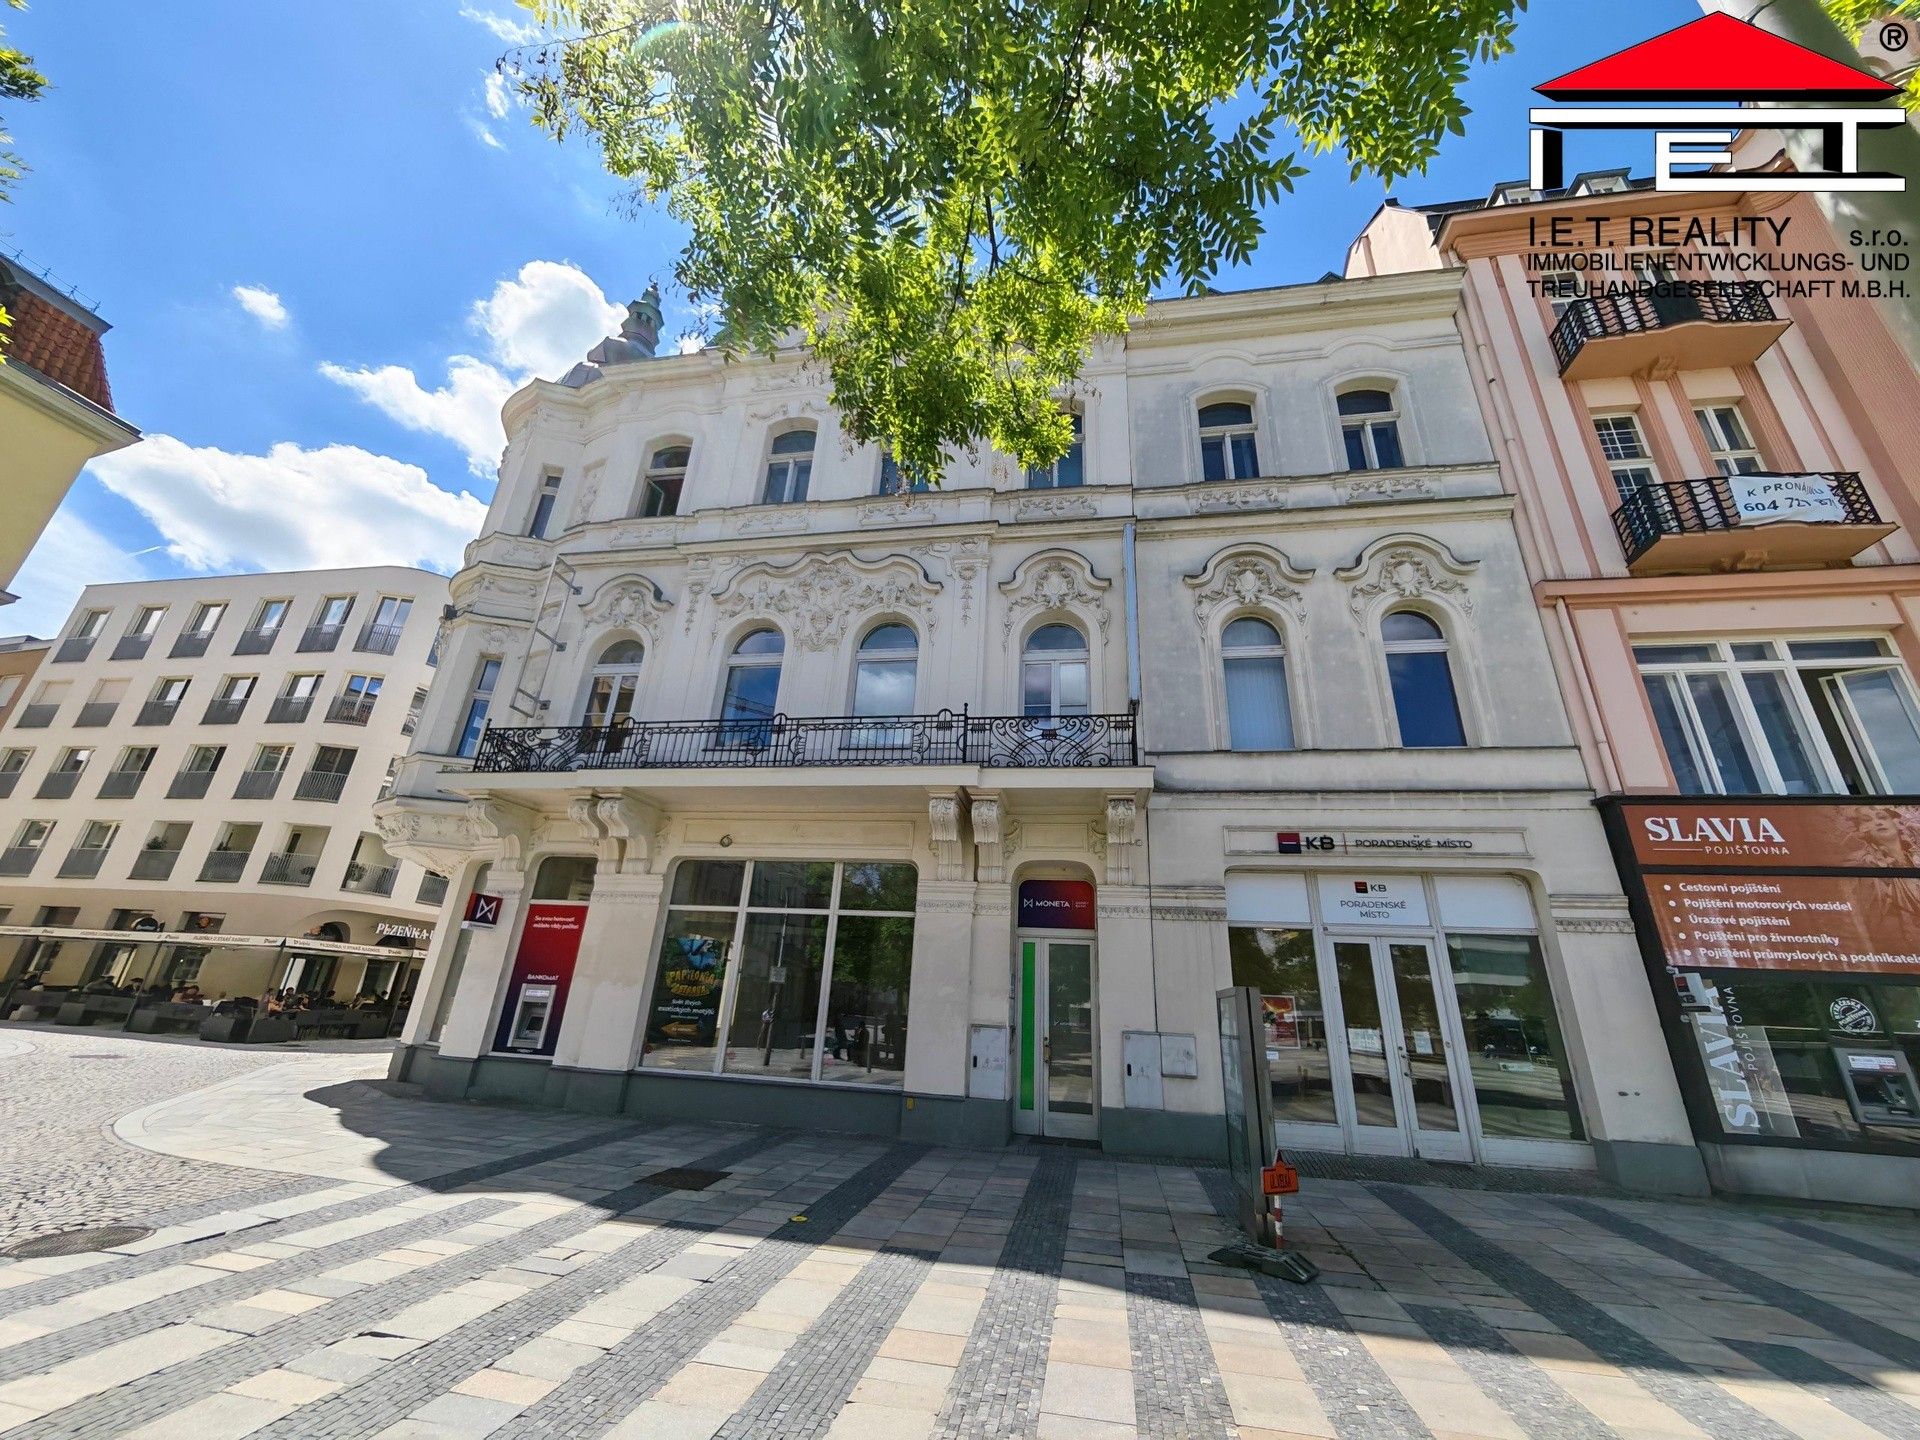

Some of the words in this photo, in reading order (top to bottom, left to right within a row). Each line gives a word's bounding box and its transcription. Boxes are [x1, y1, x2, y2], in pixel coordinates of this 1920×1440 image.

[1747, 489, 1757, 497] K
[1743, 499, 1780, 512] 604
[1644, 817, 1786, 842] SLAVIA
[1305, 835, 1336, 850] KB
[1355, 838, 1432, 849] PORADENSKÉ
[1437, 838, 1474, 849] MÍSTO
[1370, 884, 1387, 893] KB
[1679, 882, 1728, 893] Cestovní
[1730, 883, 1781, 894] pojištění
[1035, 900, 1071, 908] MONETA
[1340, 899, 1406, 910] PORADENSKÉ
[1683, 898, 1734, 909] Pojištění
[1736, 899, 1807, 911] motorových
[1808, 901, 1853, 911] vozidel
[1360, 909, 1390, 919] MÍSTO
[1689, 913, 1737, 925] Úrazové
[1738, 915, 1790, 927] pojištění
[1694, 930, 1745, 942] Pojištění
[1747, 935, 1768, 943] pro
[1770, 933, 1839, 946] živnostníky
[1699, 947, 1752, 959] Pojištění
[1753, 949, 1838, 962] průmyslových
[1694, 986, 1762, 1128] SLAVIA
